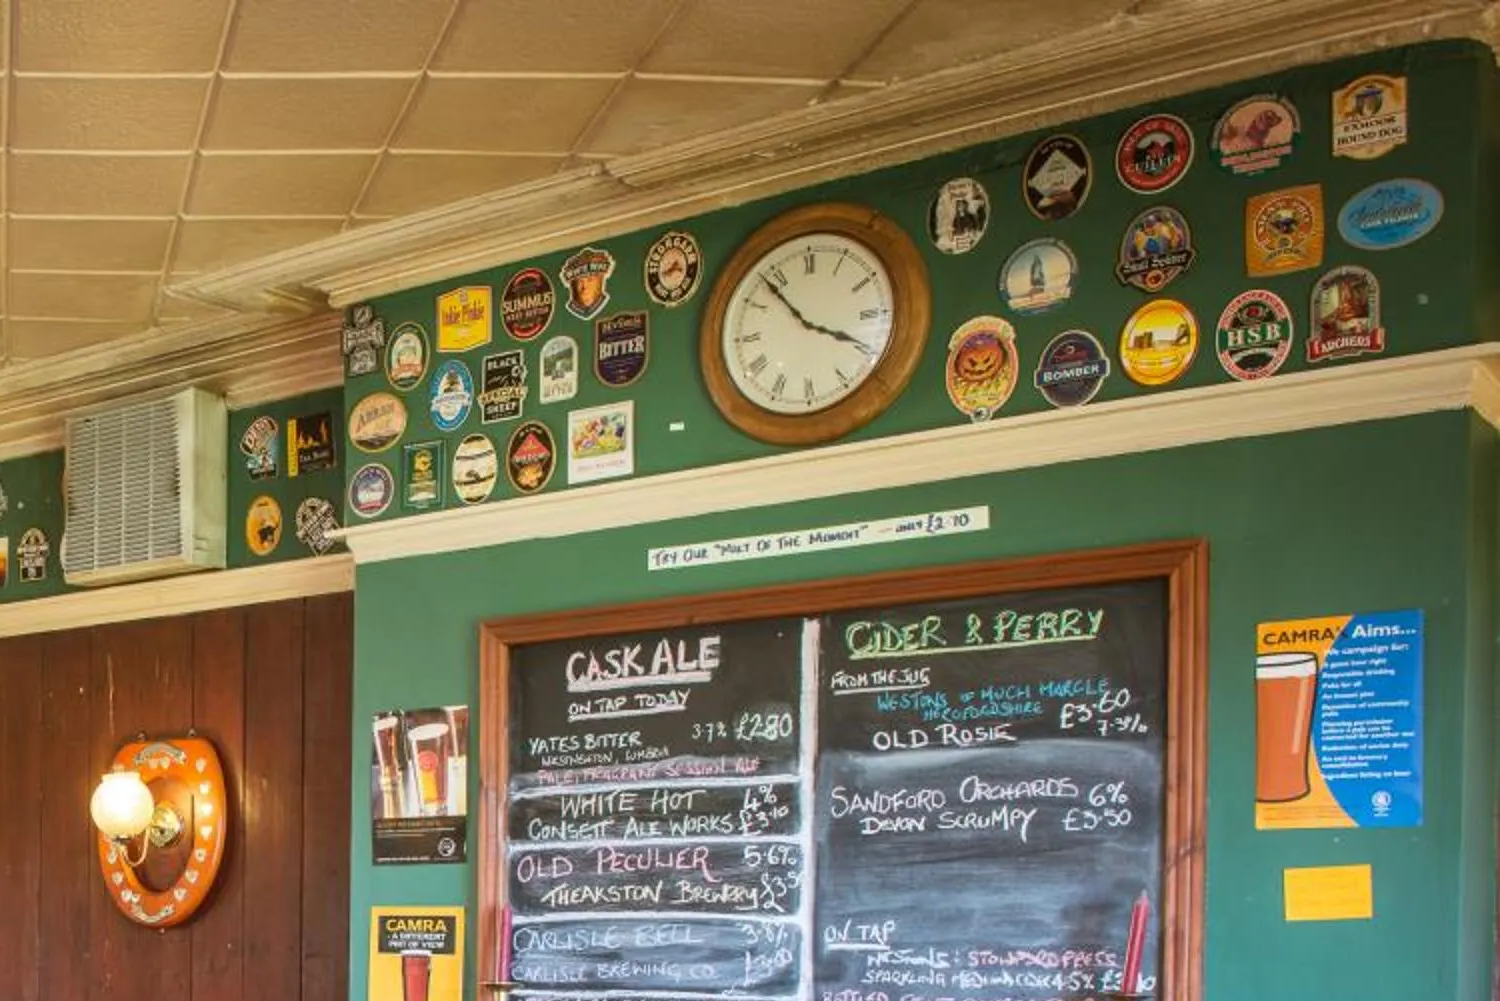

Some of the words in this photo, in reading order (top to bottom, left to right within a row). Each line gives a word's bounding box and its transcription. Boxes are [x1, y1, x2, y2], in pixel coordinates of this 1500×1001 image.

[599, 339, 645, 360] BITTER
[1043, 364, 1100, 382] BOMBER
[845, 614, 948, 653] CIDER
[964, 613, 984, 645] &
[995, 607, 1105, 642] PERRY
[566, 643, 646, 681] CASK
[651, 635, 722, 676] ALE
[568, 701, 591, 715] ON
[598, 695, 627, 712] TAP
[636, 688, 691, 709] TODAY
[528, 736, 579, 757] YATES
[584, 731, 643, 751] BITTER
[872, 728, 930, 751] OLD
[933, 723, 1019, 748] ROSIE
[561, 790, 640, 818] WHITE
[651, 789, 706, 814] HOT
[831, 785, 946, 819] SANDFORD
[959, 776, 1080, 803] ORCHARDS
[1088, 780, 1130, 807] 6%
[668, 813, 734, 836] WORKS
[937, 806, 1040, 844] SCRUMPY
[517, 855, 573, 882] OLD
[540, 880, 665, 908] THEAKSTON
[386, 919, 447, 932] CAMRA
[823, 918, 853, 945] ON
[856, 920, 897, 949] TAP
[513, 926, 622, 953] CARLISLE
